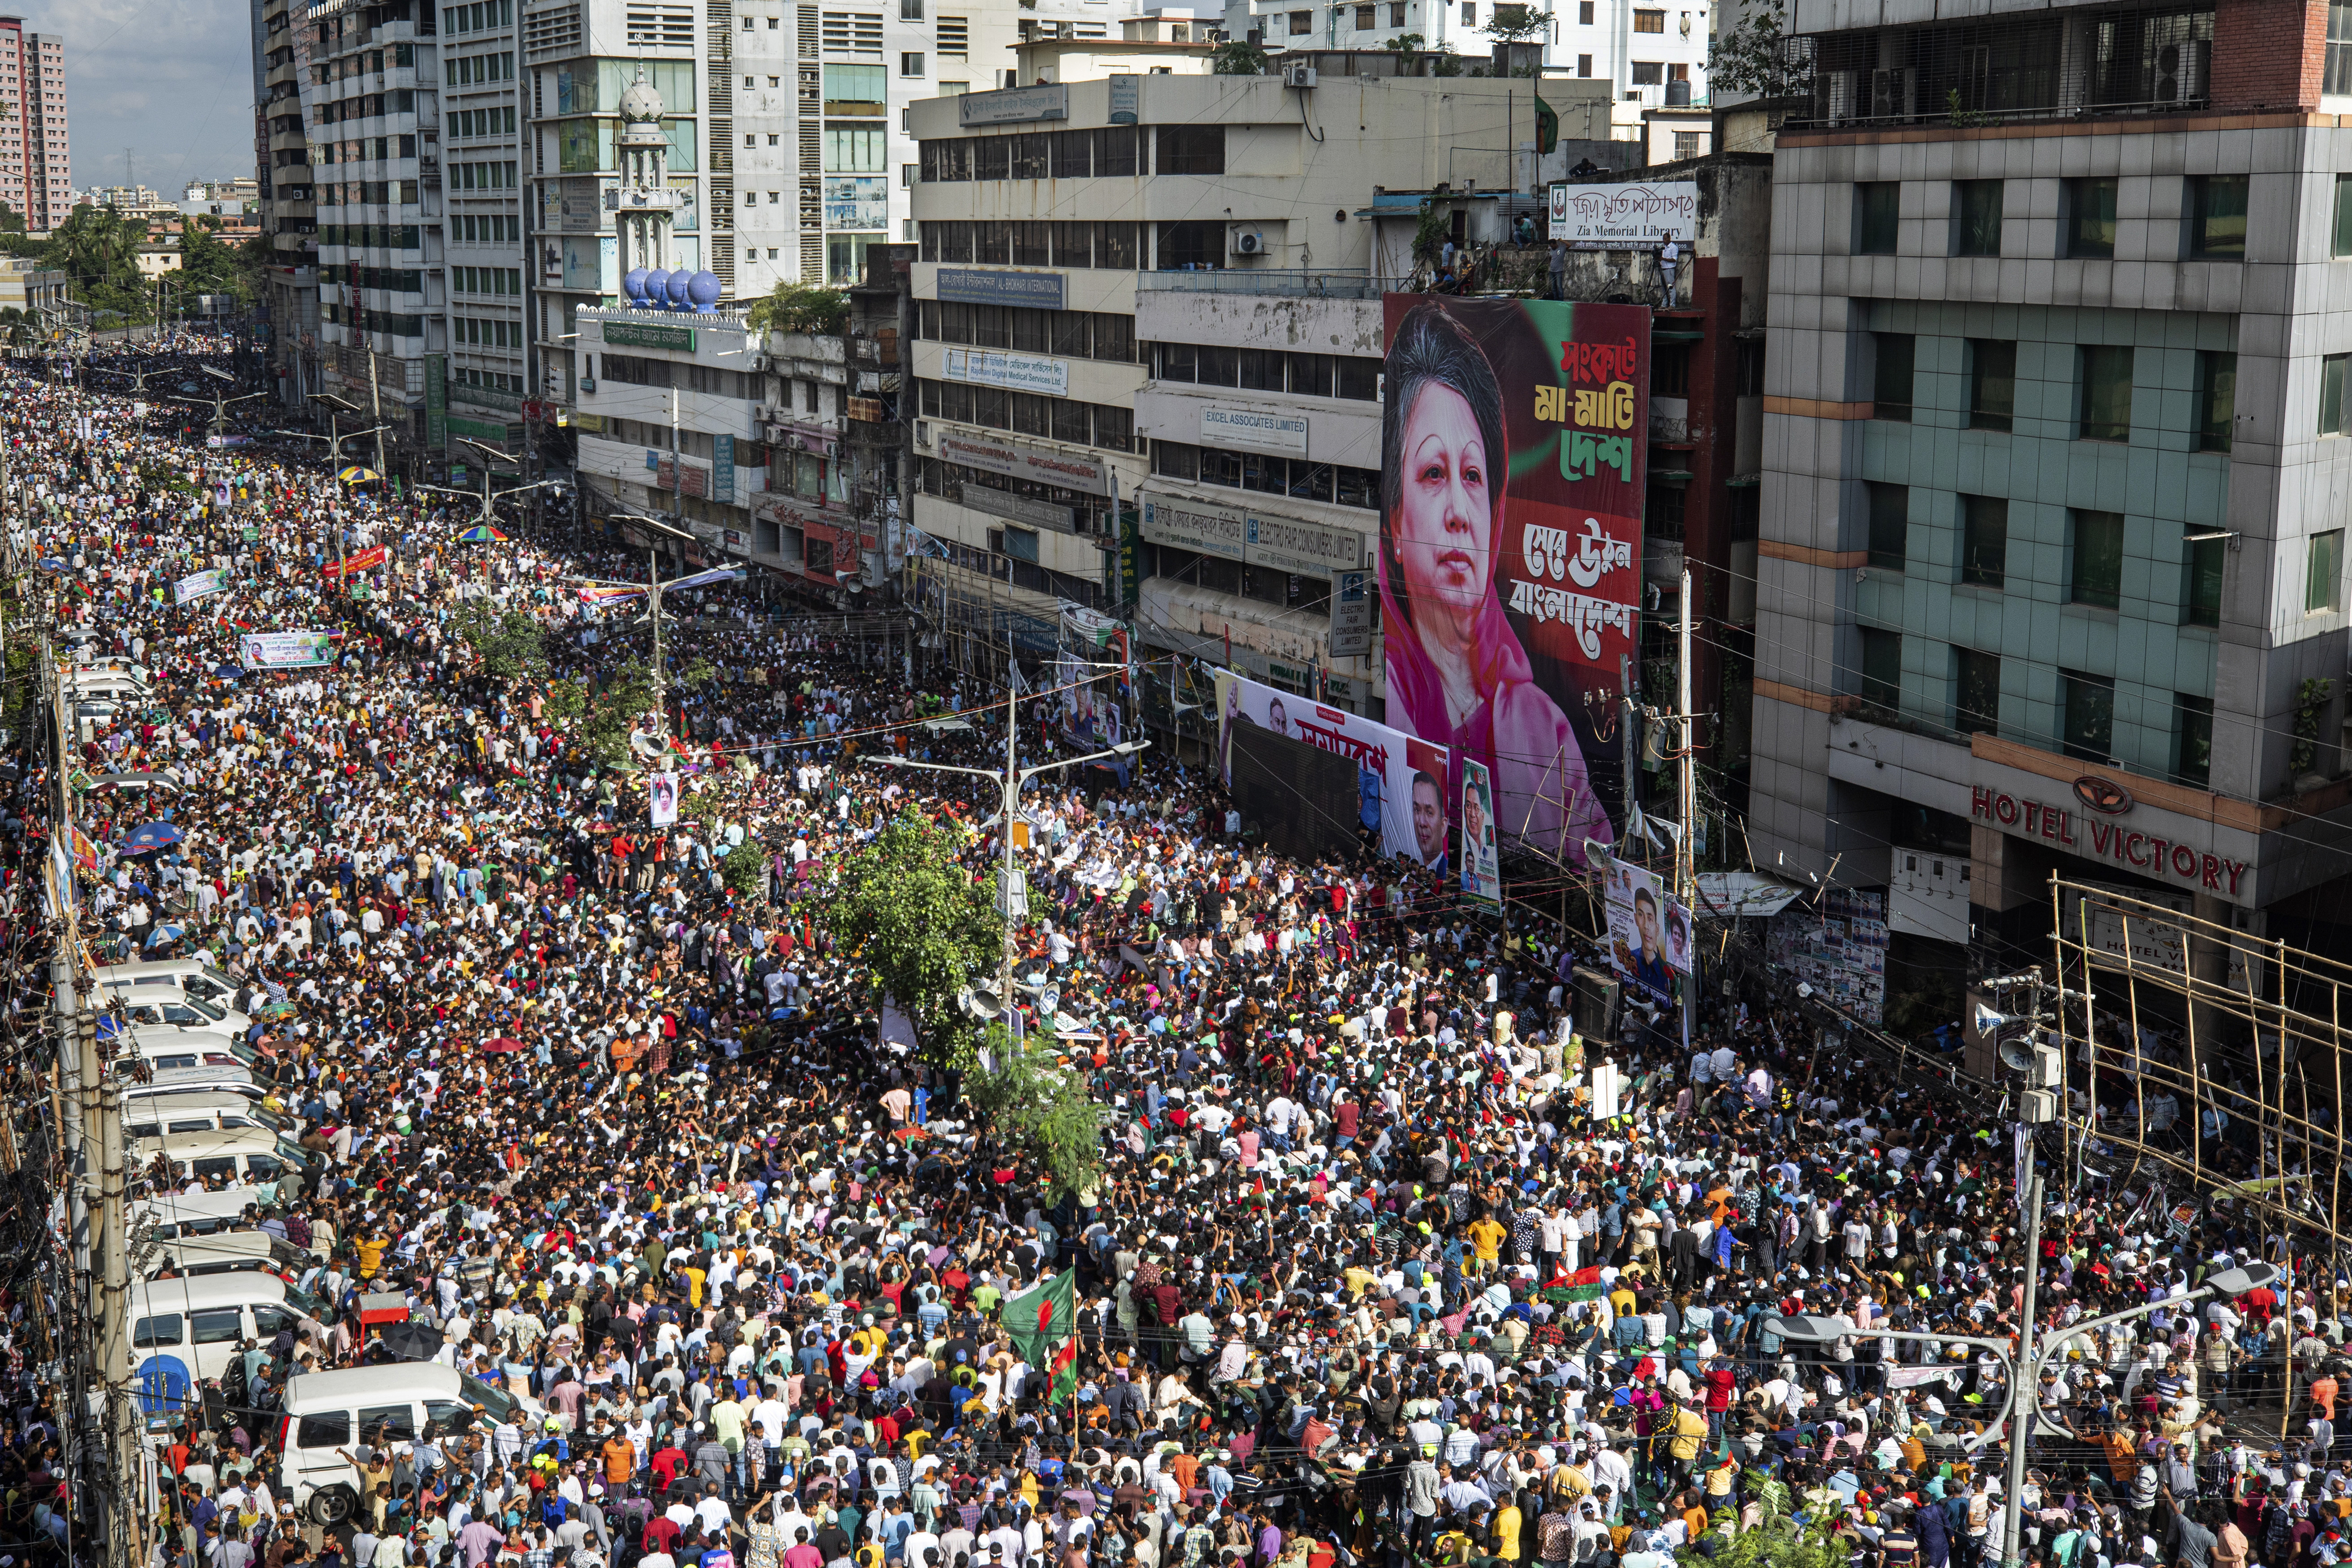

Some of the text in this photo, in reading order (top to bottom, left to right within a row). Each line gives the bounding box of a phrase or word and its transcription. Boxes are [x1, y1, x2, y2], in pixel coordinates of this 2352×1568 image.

[985, 98, 1003, 112] ইসলামী
[1003, 99, 1018, 112] লাইফ
[1048, 93, 1057, 107] লিঃ
[546, 193, 560, 204] SGH
[1568, 192, 1607, 223] জিয়া
[546, 205, 560, 213] GROUP
[1578, 225, 1682, 239] Zia Memorial Library
[1005, 278, 1027, 292] BHOKHARI
[1028, 279, 1060, 293] INTERNATIONAL
[606, 325, 688, 345] নয়াপল্টন জামে মসজিদ
[971, 355, 989, 366] রাজধানী
[990, 357, 1007, 369] ডিজিটাল
[1010, 359, 1030, 370] মেডিকেল
[1054, 363, 1062, 376] লিঃ
[1561, 337, 1636, 384] সংকটে
[971, 366, 991, 377] Rajdhani
[992, 368, 1007, 379] Digital
[1008, 371, 1027, 381] Medical
[1028, 374, 1050, 385] Services
[1052, 377, 1061, 386] Ltd.
[1535, 381, 1635, 430] মা-মাটি
[1207, 411, 1228, 423] EXCEL
[1230, 414, 1274, 429] ASSOCIATES
[1276, 419, 1305, 433] LIMITED
[1560, 429, 1632, 483] দেশ
[1023, 504, 1045, 519] DIAGNOSTIC
[1045, 508, 1061, 523] CENTRE
[1061, 511, 1070, 524] LTD.
[1174, 510, 1190, 529] ফেয়ার
[1218, 511, 1241, 539] লিমিটেড
[1259, 521, 1356, 562] ELECTRO FAIR CONSUMERS LIMITED
[1523, 517, 1632, 587] সেরে উঠুন
[1277, 556, 1288, 566] PUBALI
[1288, 558, 1296, 567] BANK
[1297, 560, 1309, 570] LIMITED
[1341, 604, 1364, 614] ELECTRO
[1346, 616, 1358, 624] FAIR
[1509, 579, 1641, 660] বাংলাদেশ
[1336, 625, 1368, 635] CONSUMERS
[1024, 636, 1058, 651] Islamic
[1341, 636, 1361, 645] LIMITED
[1269, 663, 1301, 683] PUBALI
[1972, 784, 2250, 897] HOTEL VICTORY
[1479, 857, 1494, 868] আপনার
[1476, 872, 1496, 885] বাংলাদেশ
[1611, 925, 1630, 943] নিঃশর্ত
[2107, 941, 2161, 958] HOTEL
[1622, 973, 1636, 986] রমনা
[1650, 987, 1669, 1004] ছাত্রদল
[1977, 1018, 2002, 1031] রাজ
